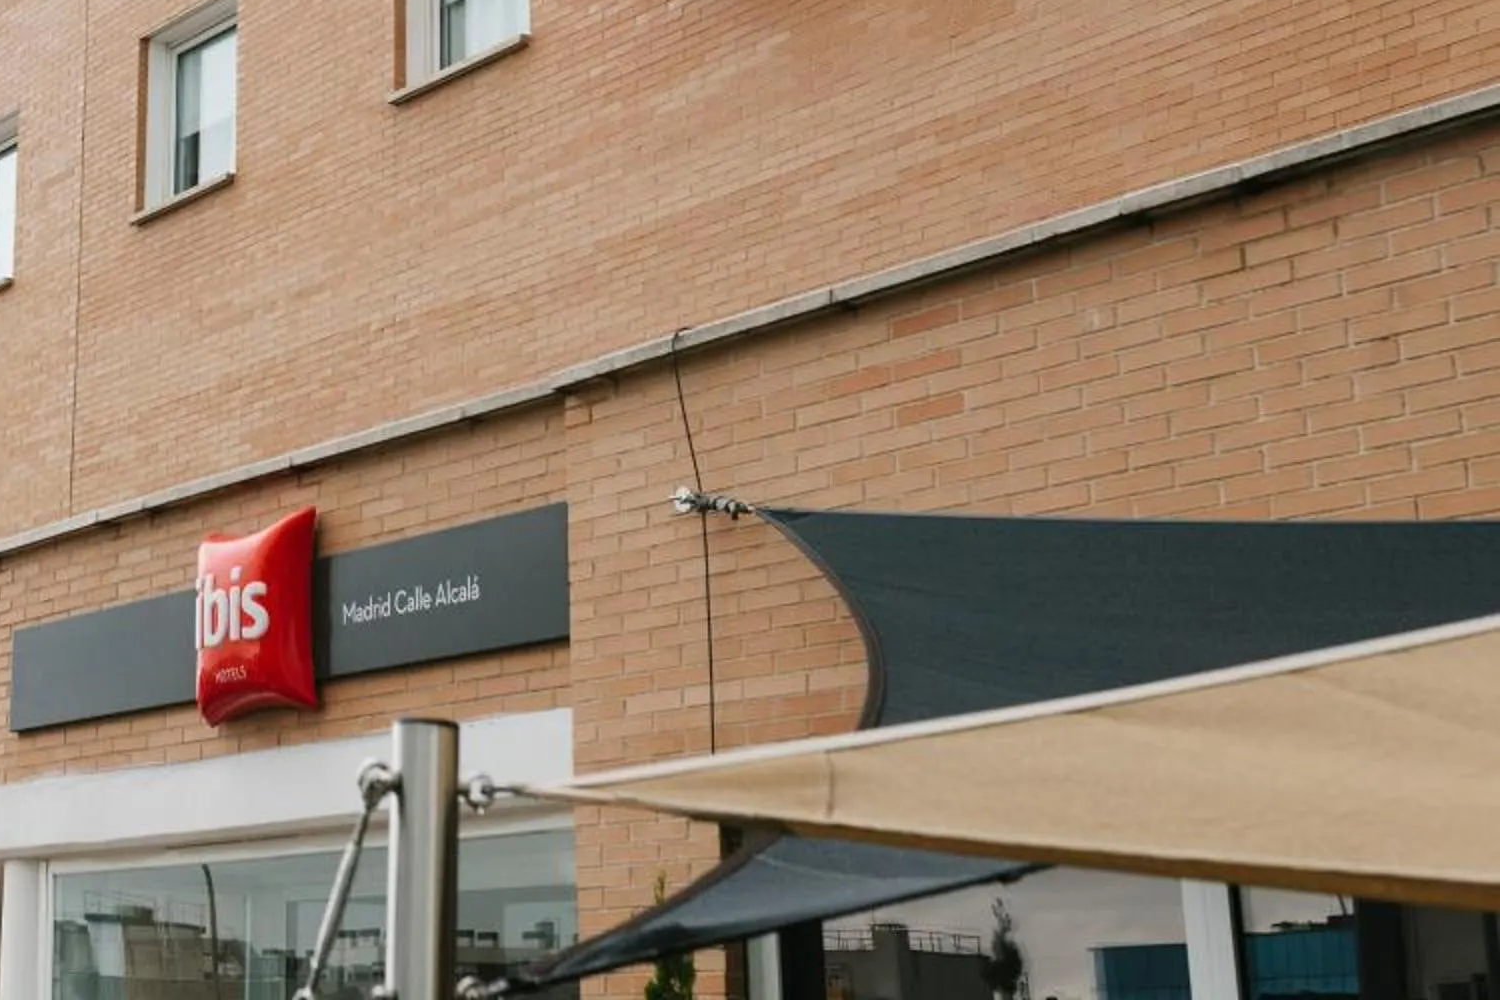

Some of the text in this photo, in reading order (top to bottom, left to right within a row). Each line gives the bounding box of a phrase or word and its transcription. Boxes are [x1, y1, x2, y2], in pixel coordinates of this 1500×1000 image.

[196, 565, 270, 649] ibis
[342, 574, 480, 626] Madrid Calle Alcalá
